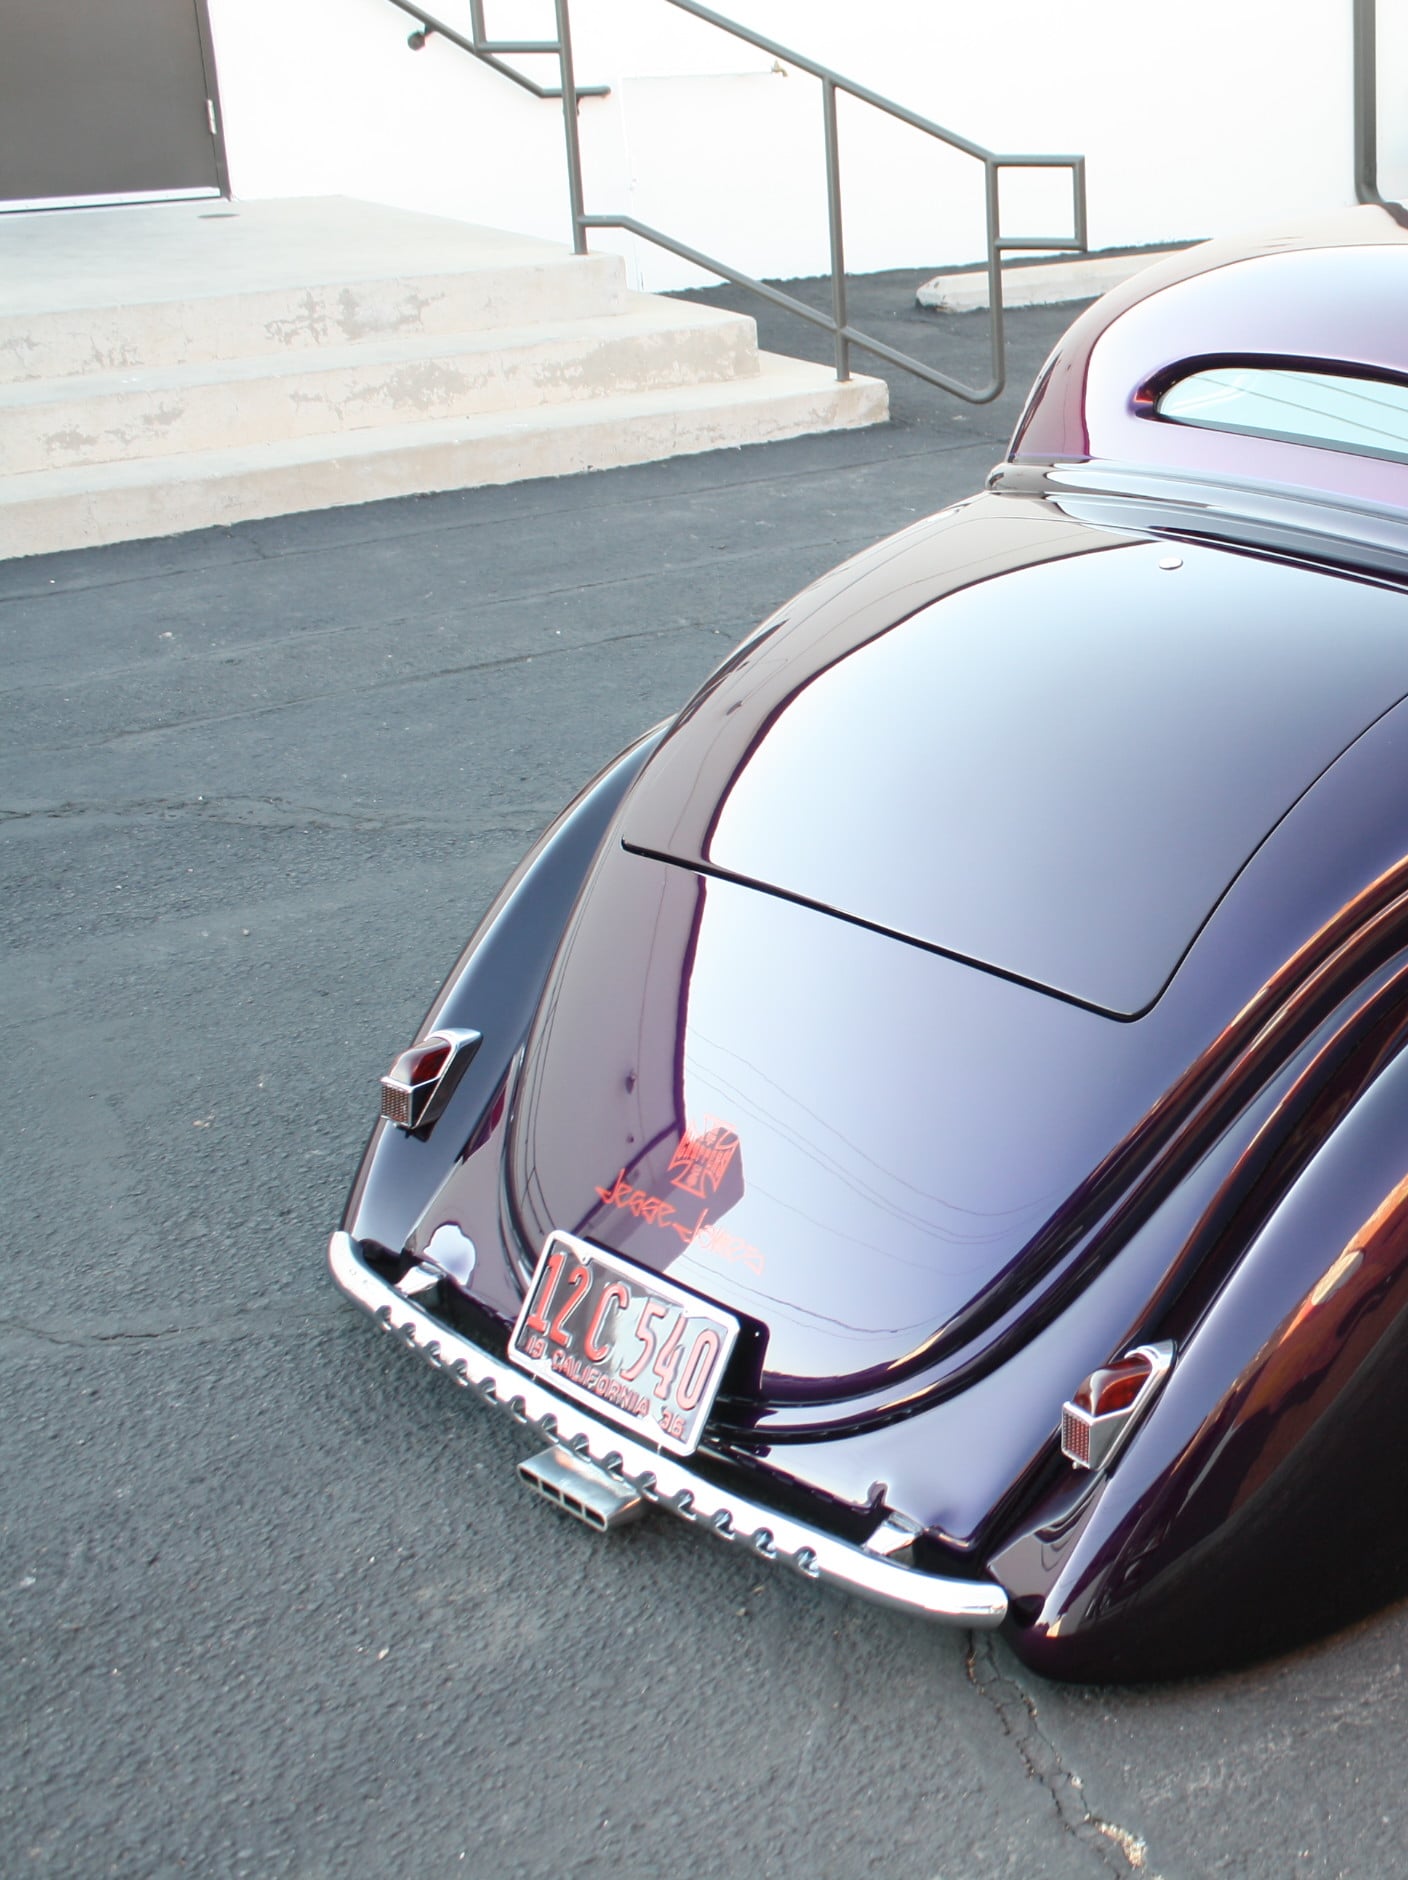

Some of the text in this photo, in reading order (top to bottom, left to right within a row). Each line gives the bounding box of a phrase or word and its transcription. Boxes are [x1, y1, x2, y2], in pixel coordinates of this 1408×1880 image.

[524, 1336, 546, 1359] 19
[551, 1349, 650, 1417] CALIFORNIA
[620, 1301, 721, 1411] 540
